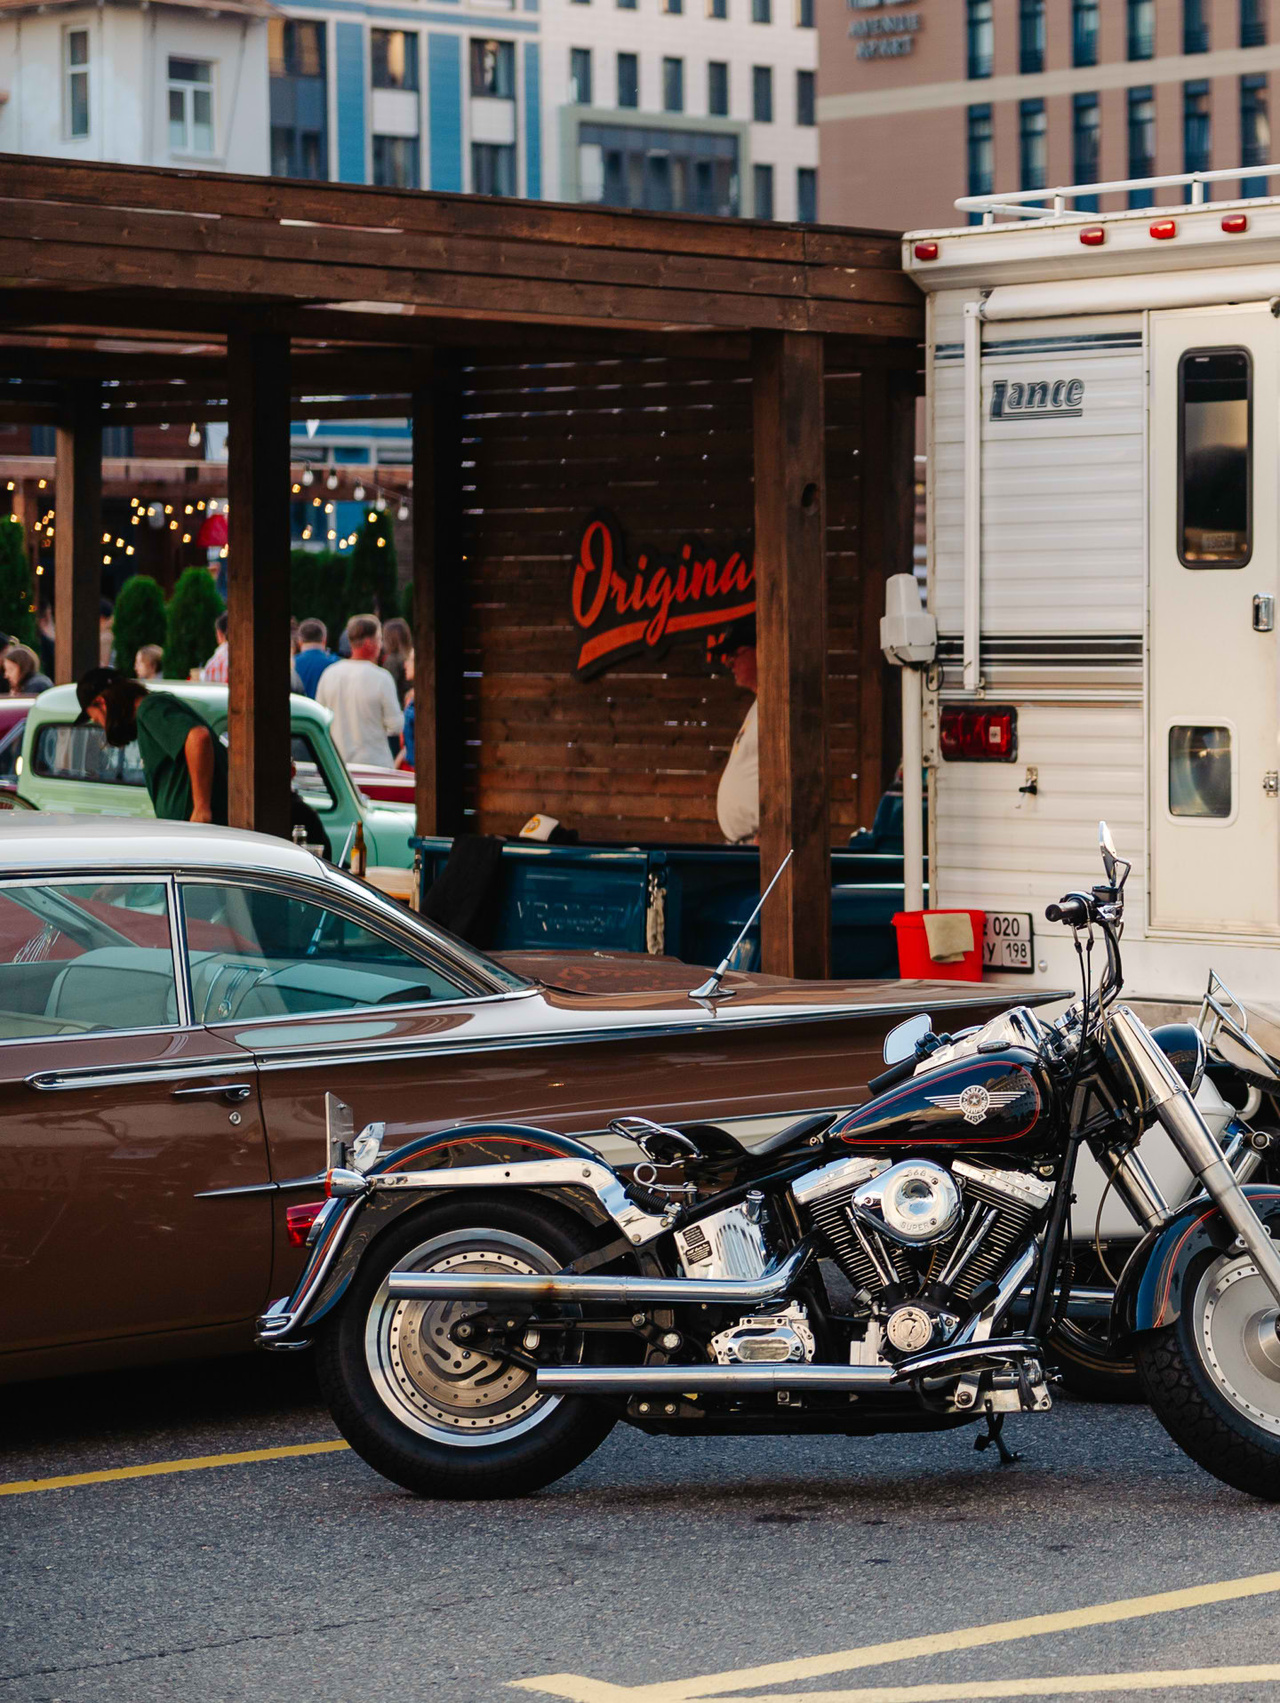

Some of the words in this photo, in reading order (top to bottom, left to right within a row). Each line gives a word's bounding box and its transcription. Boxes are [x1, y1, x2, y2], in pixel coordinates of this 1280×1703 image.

[990, 379, 1085, 421] Lance
[572, 520, 757, 647] Origina
[983, 916, 1020, 937] 020
[1006, 942, 1027, 958] 198
[966, 1114, 984, 1123] USA
[900, 1221, 931, 1232] SUPER
